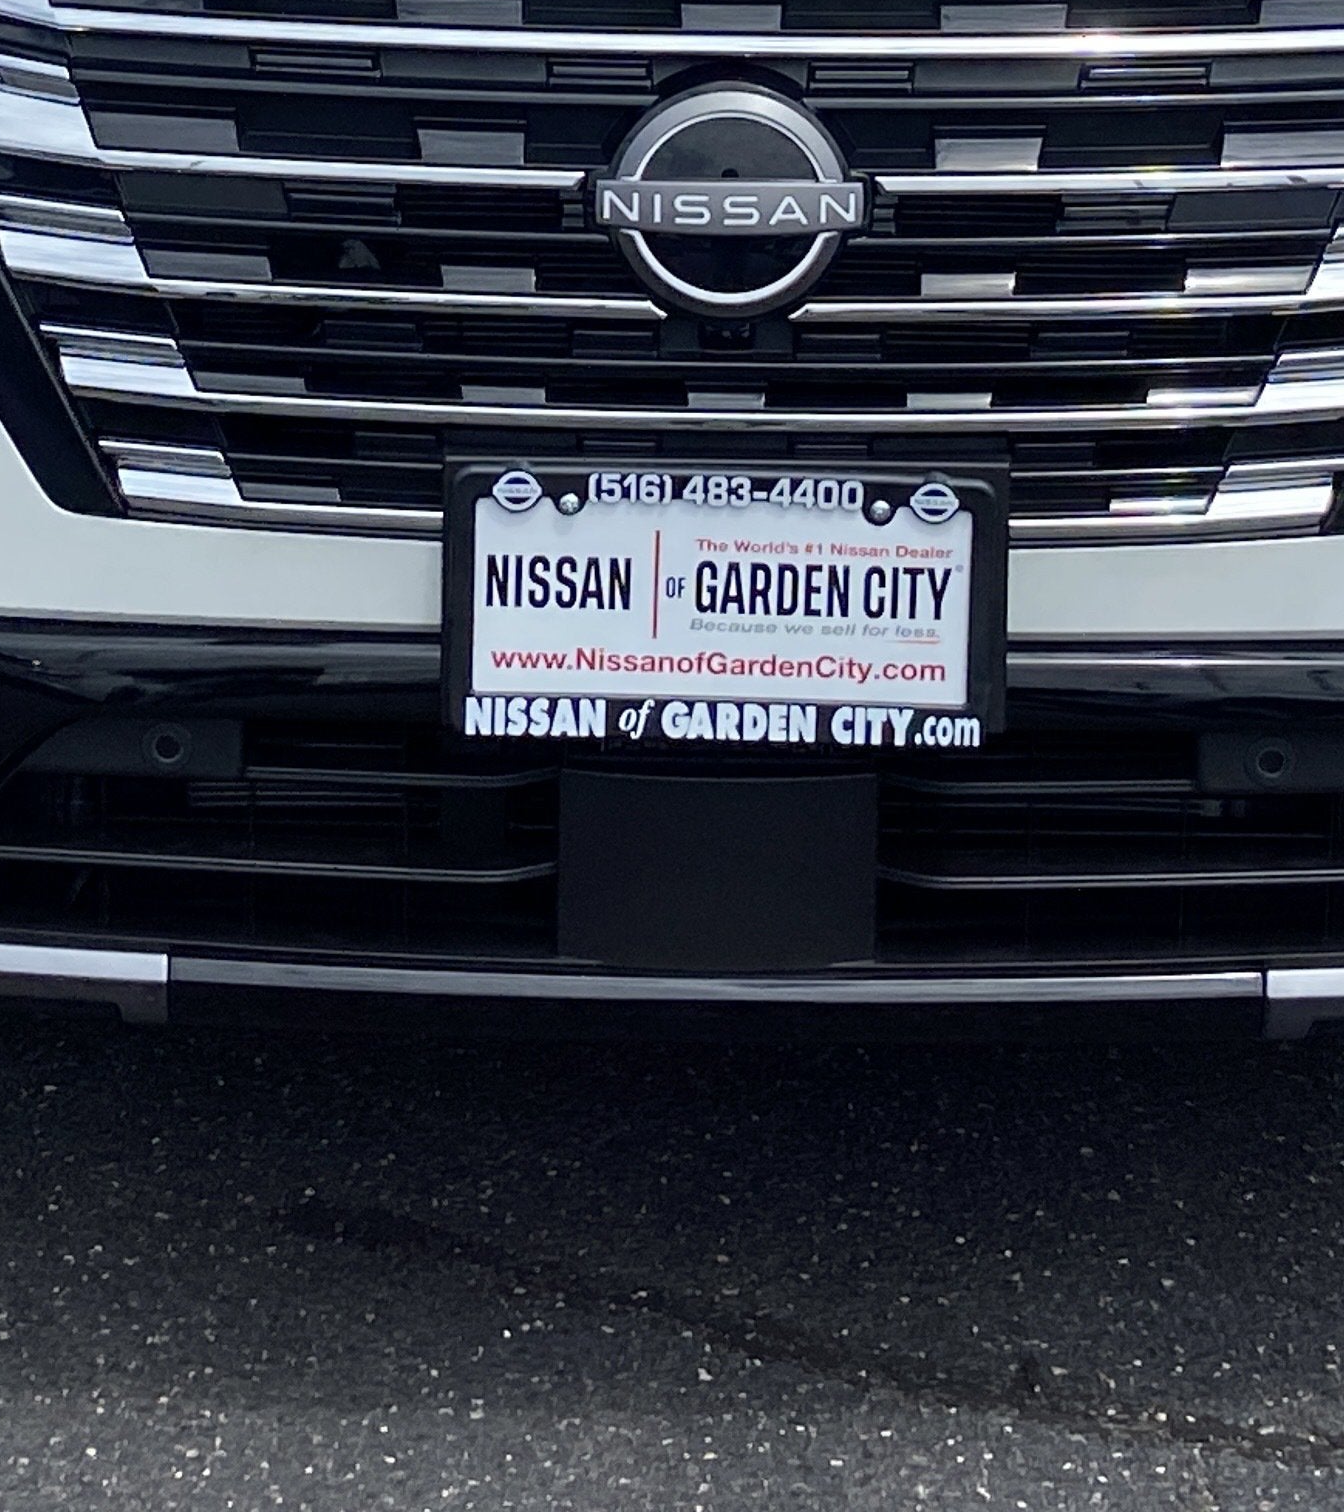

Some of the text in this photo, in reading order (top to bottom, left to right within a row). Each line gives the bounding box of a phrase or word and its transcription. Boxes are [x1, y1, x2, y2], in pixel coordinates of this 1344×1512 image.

[602, 189, 856, 226] NISSAN
[588, 472, 865, 511] (516) 483-4400
[696, 538, 954, 559] The World's #1 Nissan Dealer
[485, 554, 953, 620] NISSAN OF GARDEN CITY
[689, 618, 778, 634] Because
[785, 624, 814, 635] we
[820, 622, 857, 636] sell
[862, 623, 890, 637] for
[491, 647, 946, 684] www.NissanofGardenCity.com
[465, 696, 981, 747] NISSAN of GARDEN CITY.com
